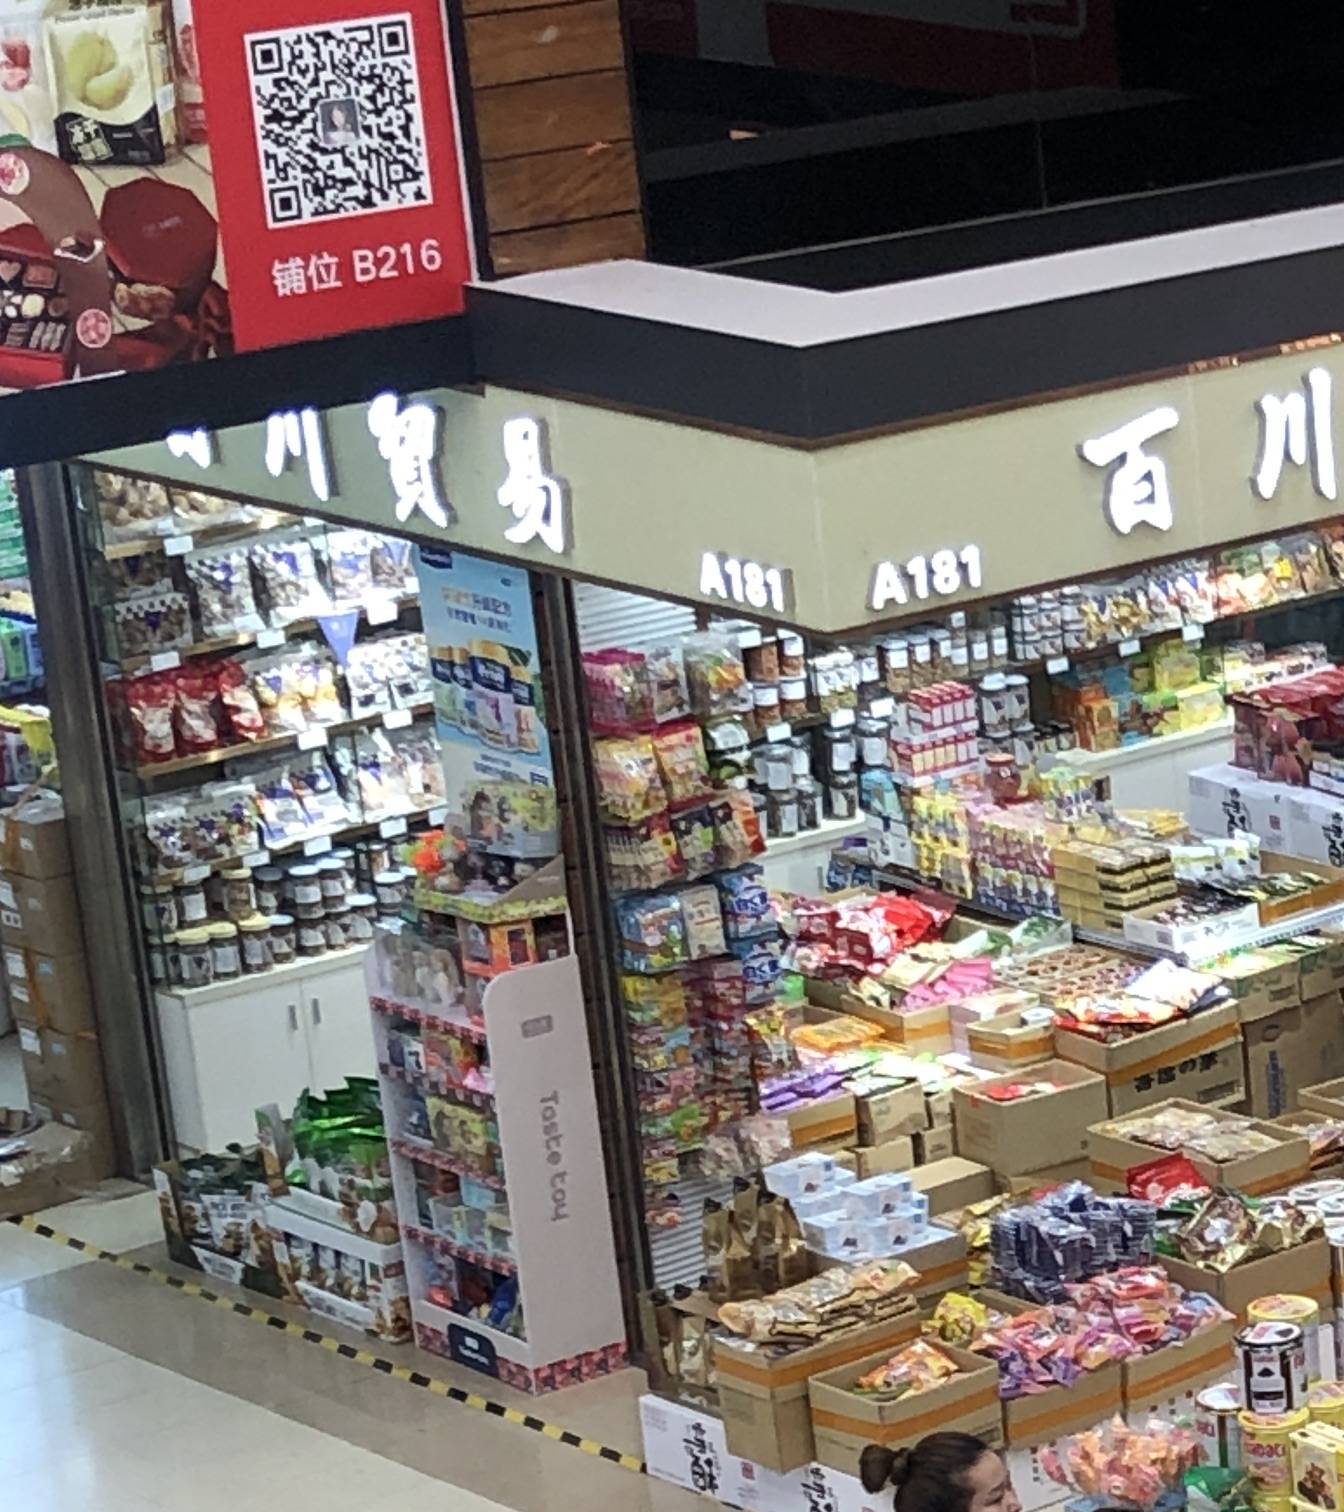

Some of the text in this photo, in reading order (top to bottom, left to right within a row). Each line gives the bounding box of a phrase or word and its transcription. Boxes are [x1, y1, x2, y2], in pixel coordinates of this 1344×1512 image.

[270, 239, 443, 297] 铺位 B216
[698, 552, 785, 612] A181
[871, 544, 982, 611] A181
[539, 1089, 564, 1166] Taste
